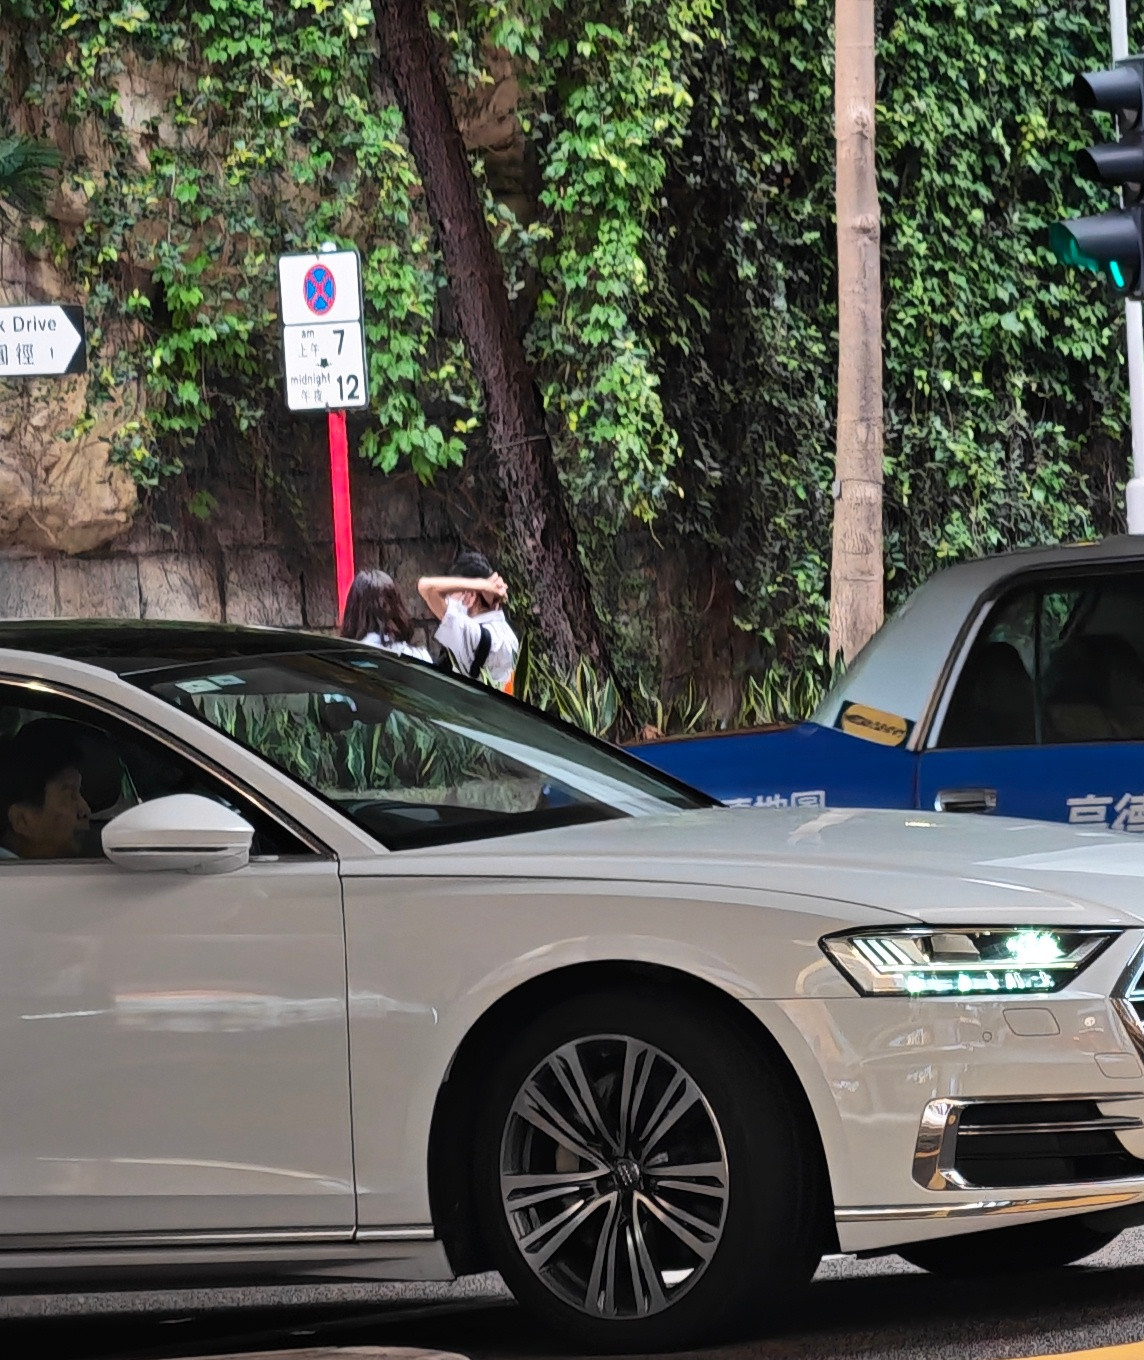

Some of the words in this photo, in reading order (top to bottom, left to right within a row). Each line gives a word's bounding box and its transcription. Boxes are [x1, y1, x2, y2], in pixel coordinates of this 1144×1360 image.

[13, 315, 57, 332] Drive
[301, 329, 315, 339] am
[332, 328, 345, 356] 7
[290, 372, 331, 388] midnight
[336, 374, 360, 402] 12
